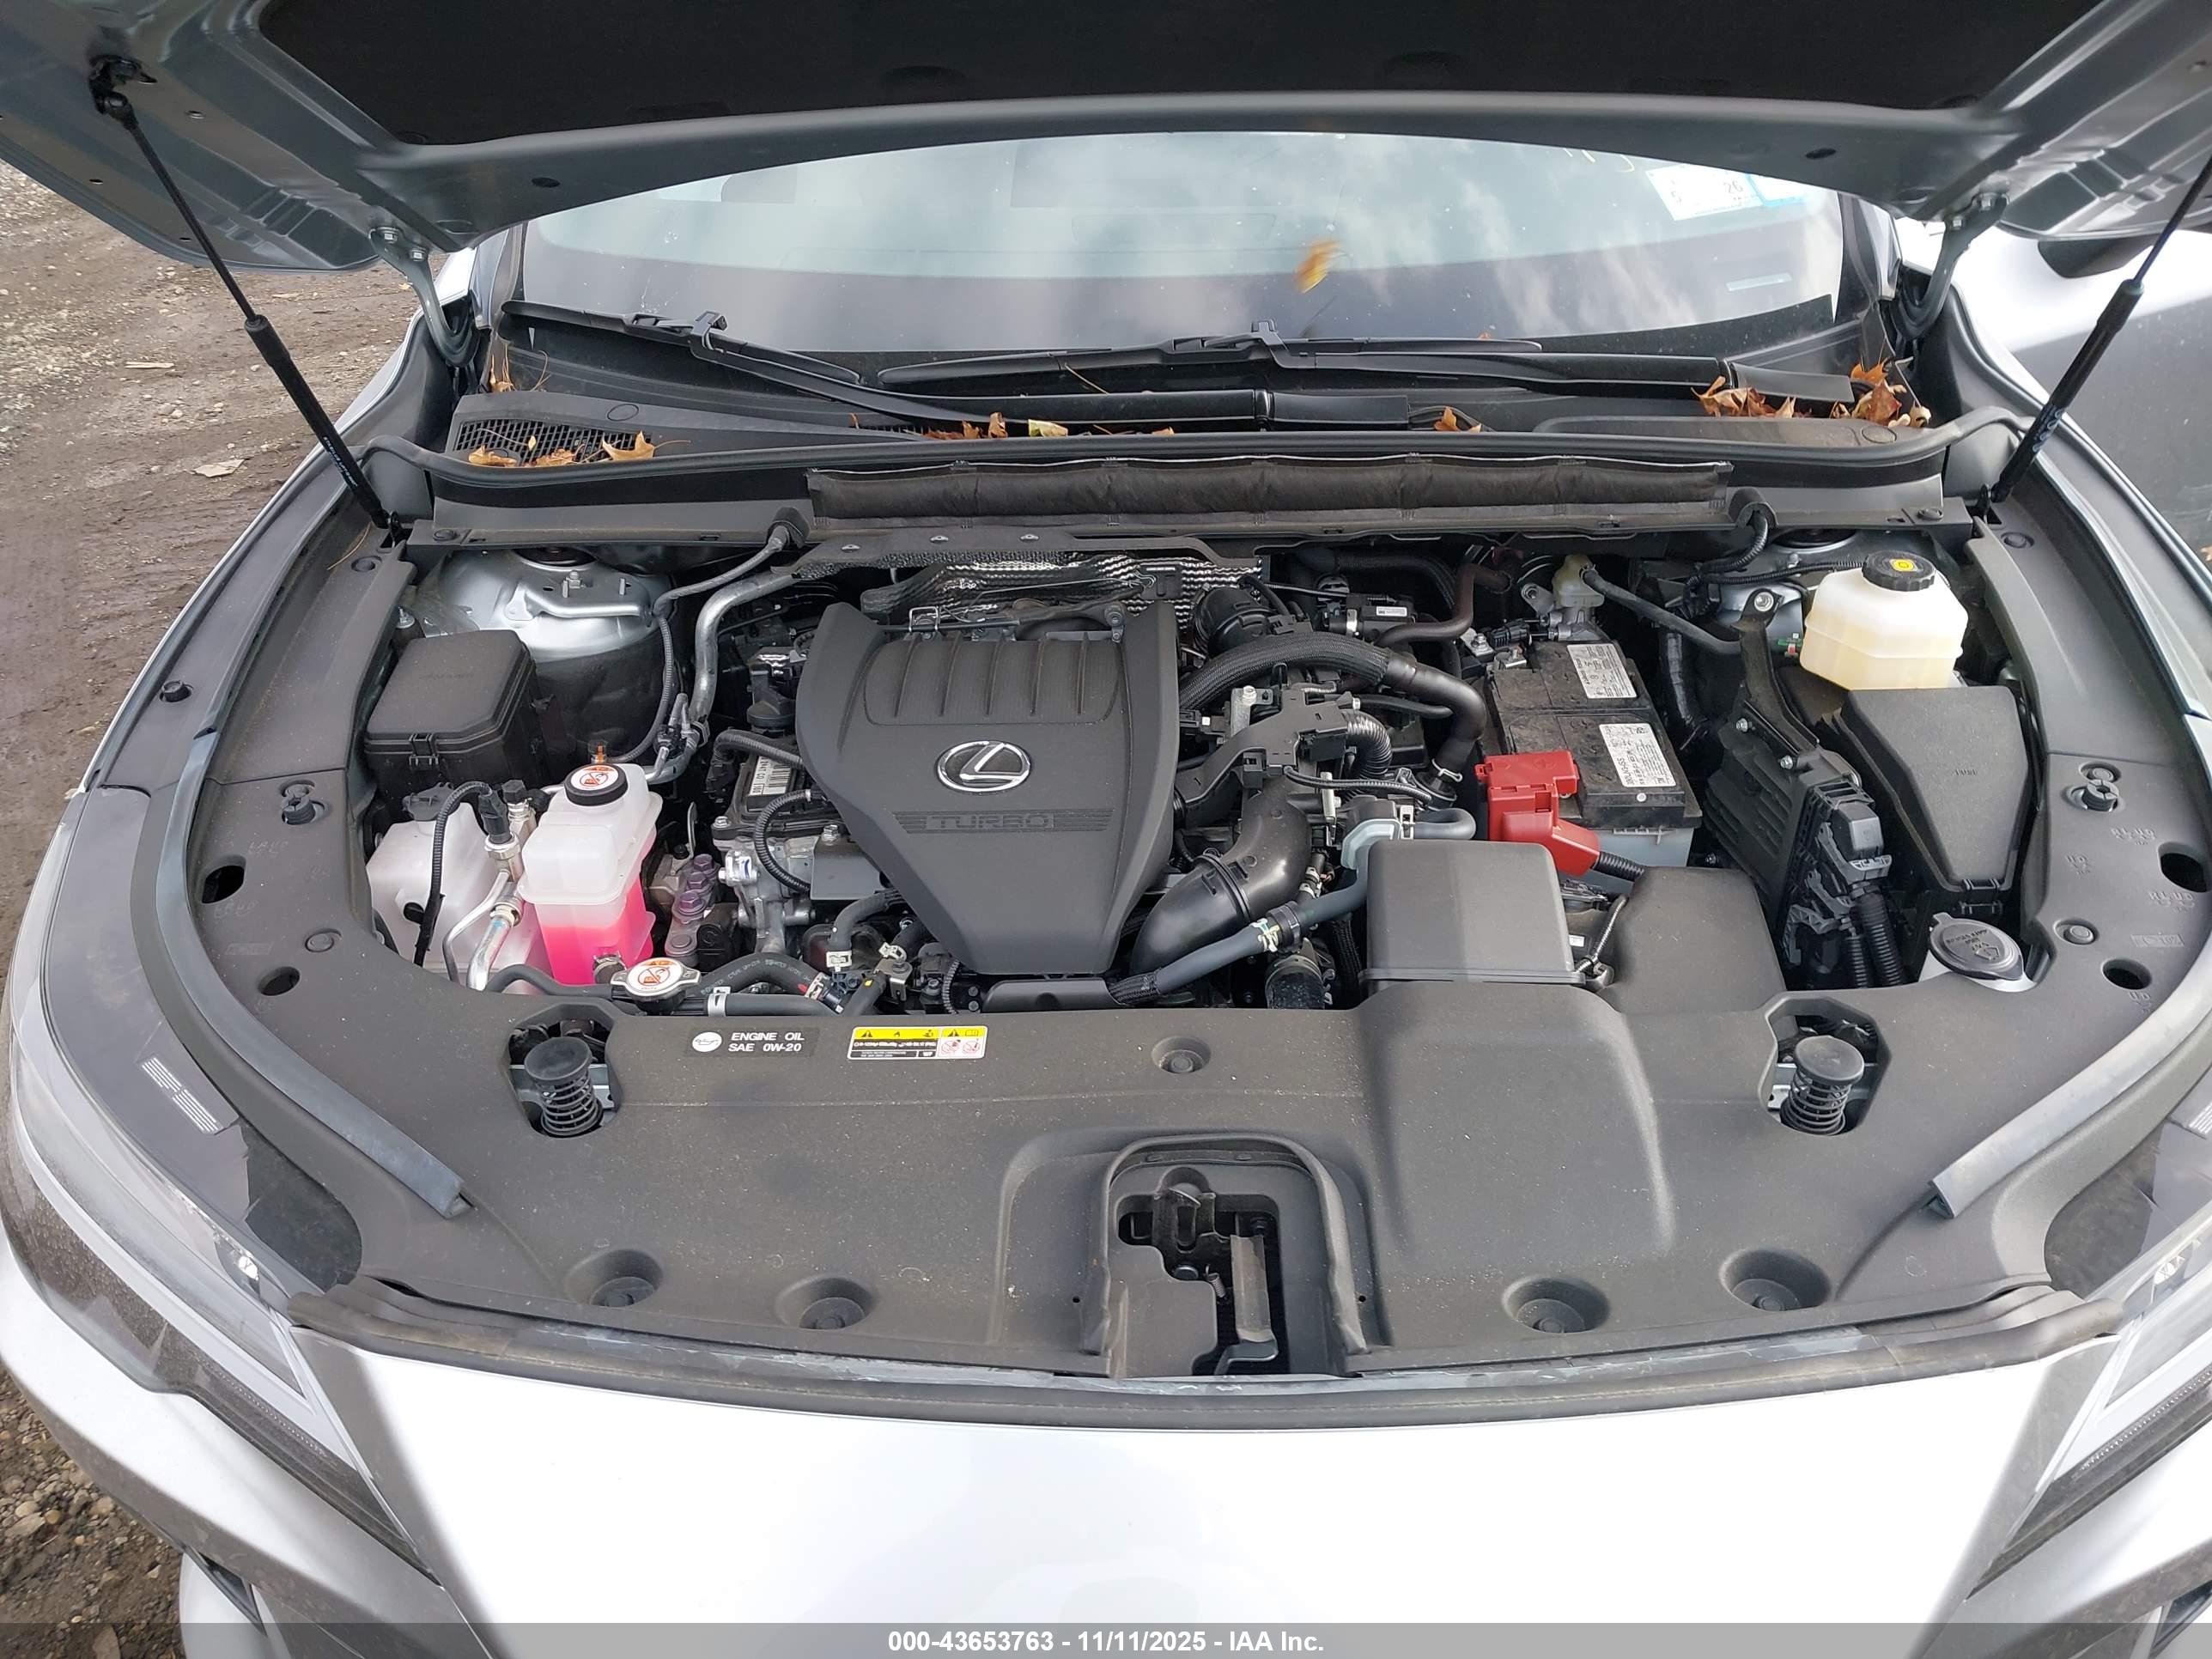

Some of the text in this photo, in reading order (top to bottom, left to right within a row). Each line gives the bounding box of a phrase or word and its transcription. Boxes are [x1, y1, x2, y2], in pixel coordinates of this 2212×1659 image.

[932, 815, 1048, 829] TURBO
[731, 1032, 805, 1041] ENGINE OIL
[728, 1043, 802, 1052] SAE 0W-20
